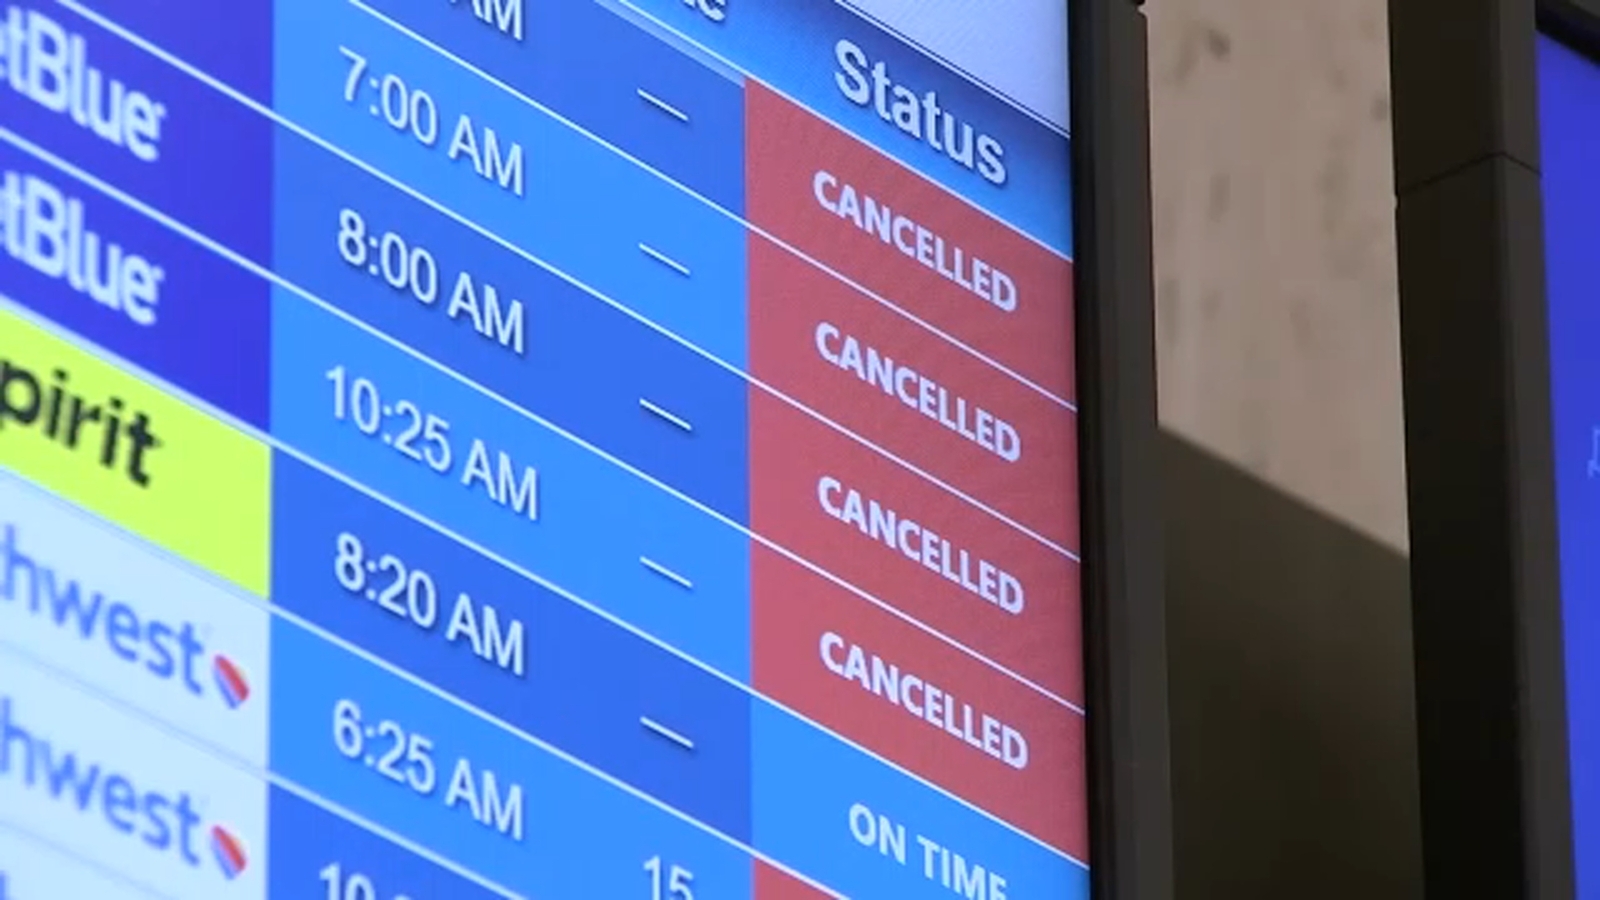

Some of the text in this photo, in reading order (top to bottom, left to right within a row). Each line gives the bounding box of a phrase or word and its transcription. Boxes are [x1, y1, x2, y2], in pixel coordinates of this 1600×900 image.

[0, 5, 167, 162] tBlue
[339, 46, 524, 197] 7:00 AM
[833, 39, 1008, 185] Status
[0, 170, 165, 326] tBlue
[337, 208, 524, 354] 8:00 AM
[812, 170, 1018, 313] CANCELLED
[325, 365, 538, 521] 10:25 AM
[814, 322, 1021, 463] CANCELLED
[0, 523, 205, 697] hwest
[334, 532, 524, 676] 8:20 AM
[817, 476, 1025, 615] CANCELLED
[333, 699, 524, 841] 6:25 AM
[819, 631, 1029, 770] CANCELLED
[643, 855, 694, 900] 15
[848, 803, 906, 866] ON
